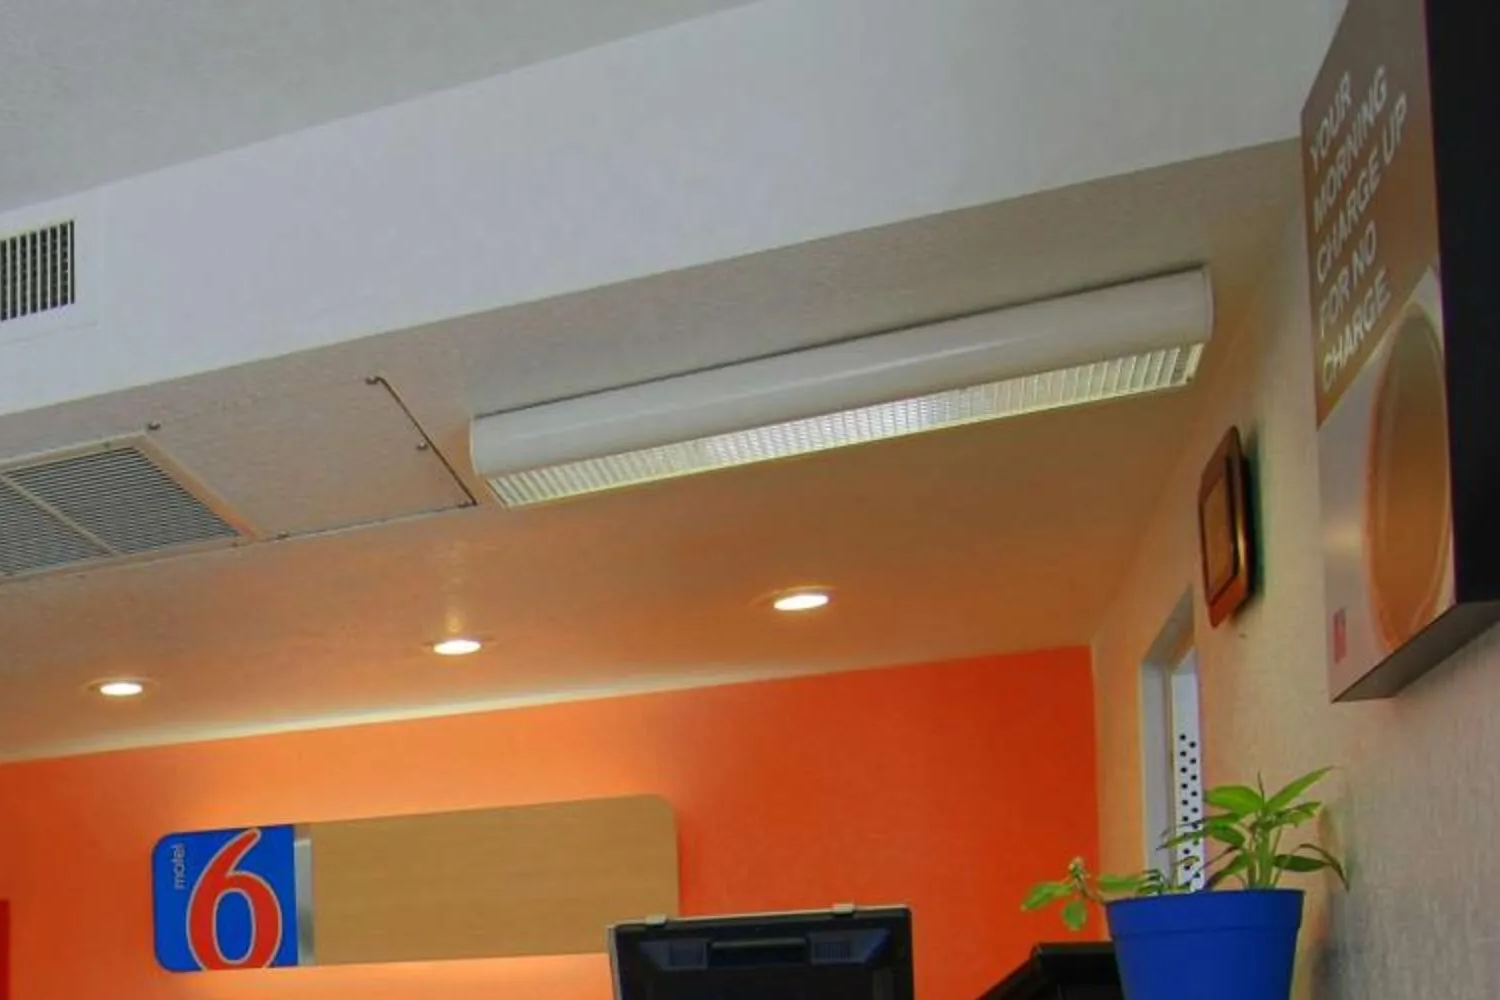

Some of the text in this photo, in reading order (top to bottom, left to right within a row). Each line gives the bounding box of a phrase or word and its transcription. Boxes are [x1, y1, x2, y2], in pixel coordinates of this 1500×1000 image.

[1310, 71, 1352, 174] YOUR
[1313, 65, 1387, 234] MORNING
[1317, 90, 1407, 283] CHARGE UP
[1319, 219, 1377, 340] FOR NO
[1322, 266, 1392, 393] CHARGE
[171, 828, 283, 971] motel 6
